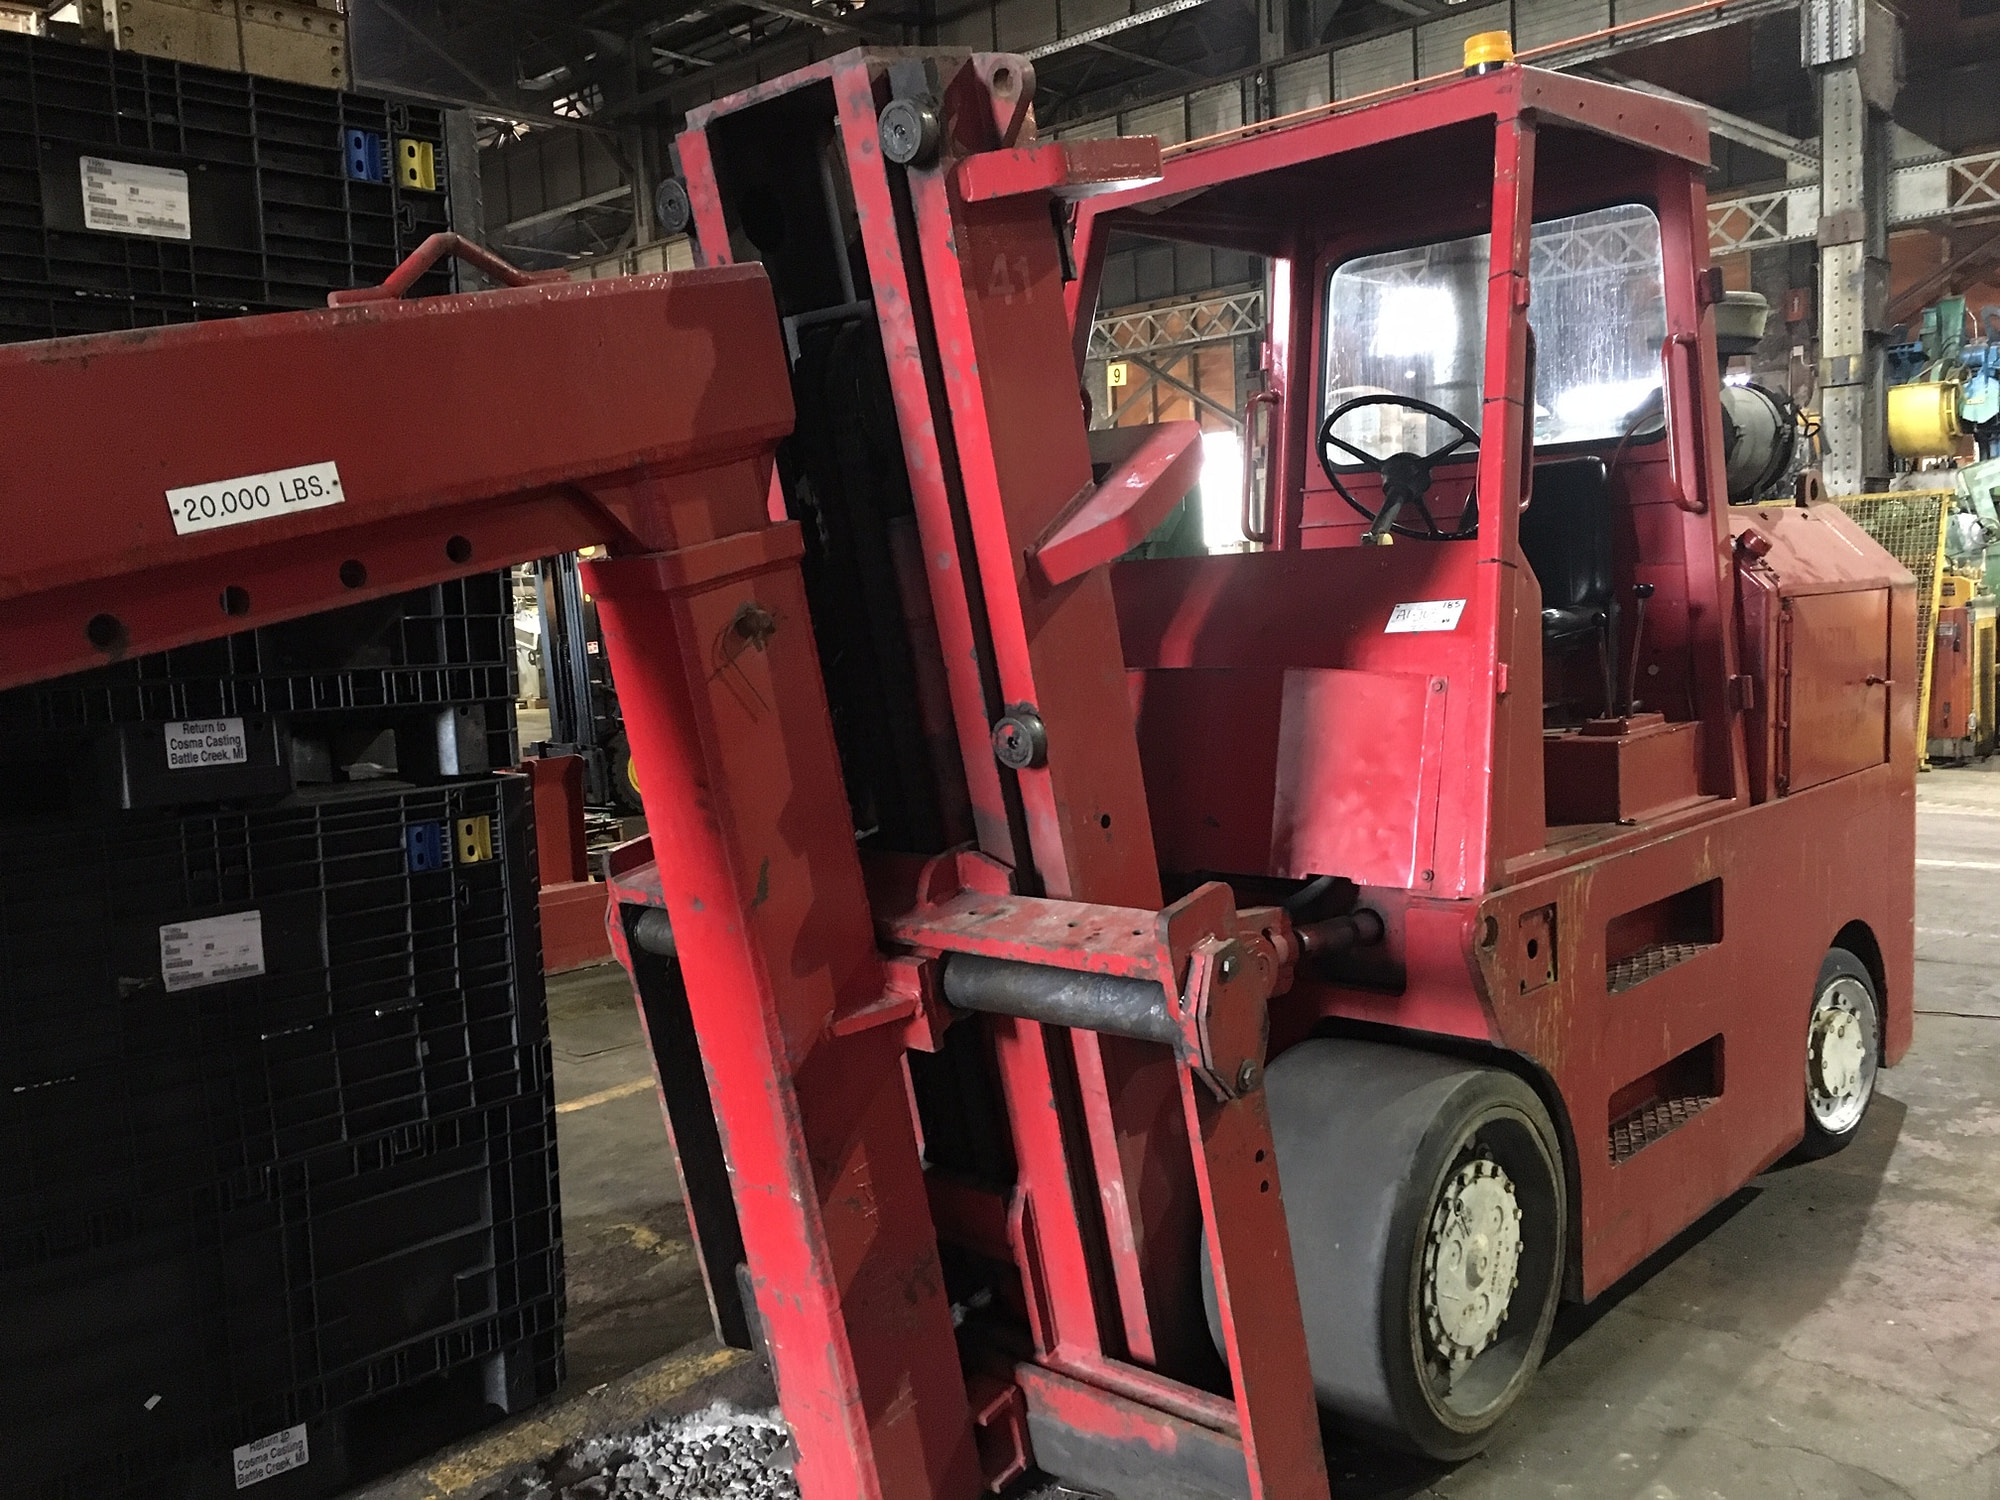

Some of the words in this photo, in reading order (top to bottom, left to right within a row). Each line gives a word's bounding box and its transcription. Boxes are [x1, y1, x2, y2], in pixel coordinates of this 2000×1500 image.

[1114, 368, 1121, 383] 9
[279, 475, 331, 503] LBS.
[182, 723, 215, 735] Return
[216, 721, 226, 732] to
[170, 738, 203, 750] Cosma
[205, 735, 242, 748] Casting
[170, 752, 199, 765] Battle
[232, 747, 244, 759] MI
[237, 1453, 269, 1471] Cosma
[270, 1440, 304, 1459] Casting
[237, 1468, 264, 1485] Battle
